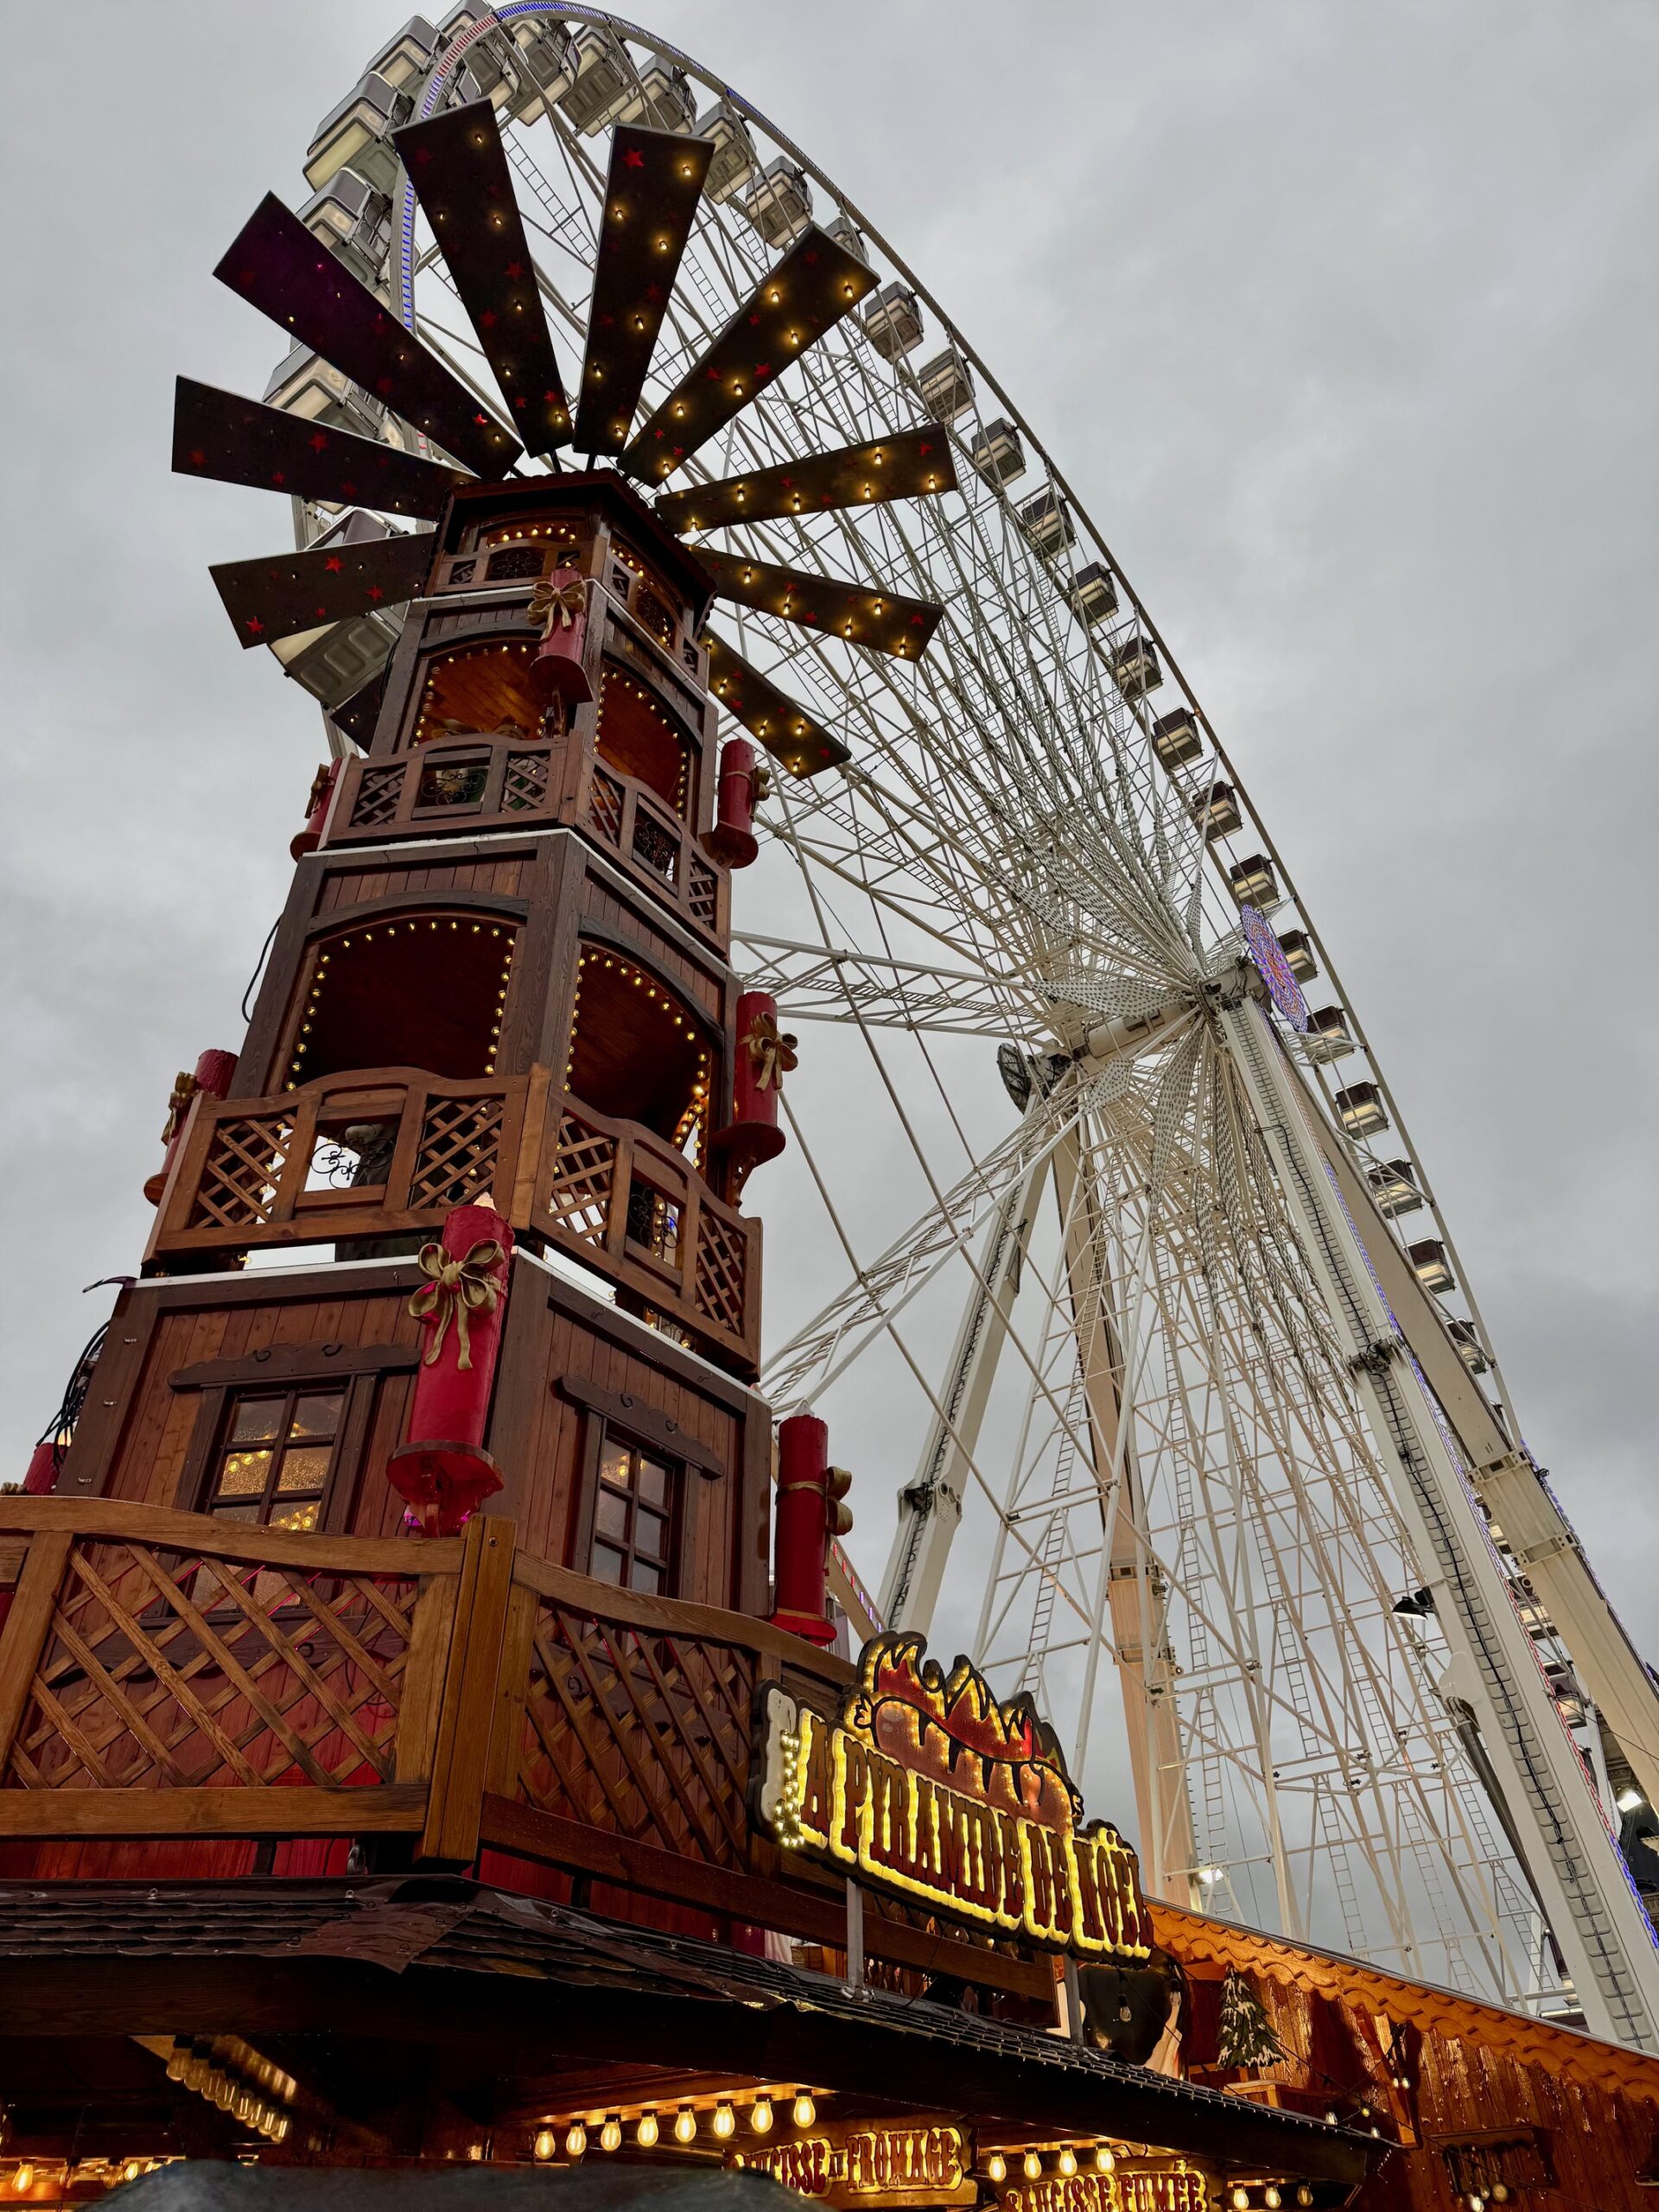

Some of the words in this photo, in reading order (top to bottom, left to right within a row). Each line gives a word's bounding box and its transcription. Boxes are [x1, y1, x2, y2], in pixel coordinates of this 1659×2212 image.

[842, 1735, 1024, 1918] PYRAMIDE
[1026, 1823, 1073, 1934] DE
[1072, 1831, 1154, 1949] NOËL
[845, 2131, 957, 2189] FROMAGE
